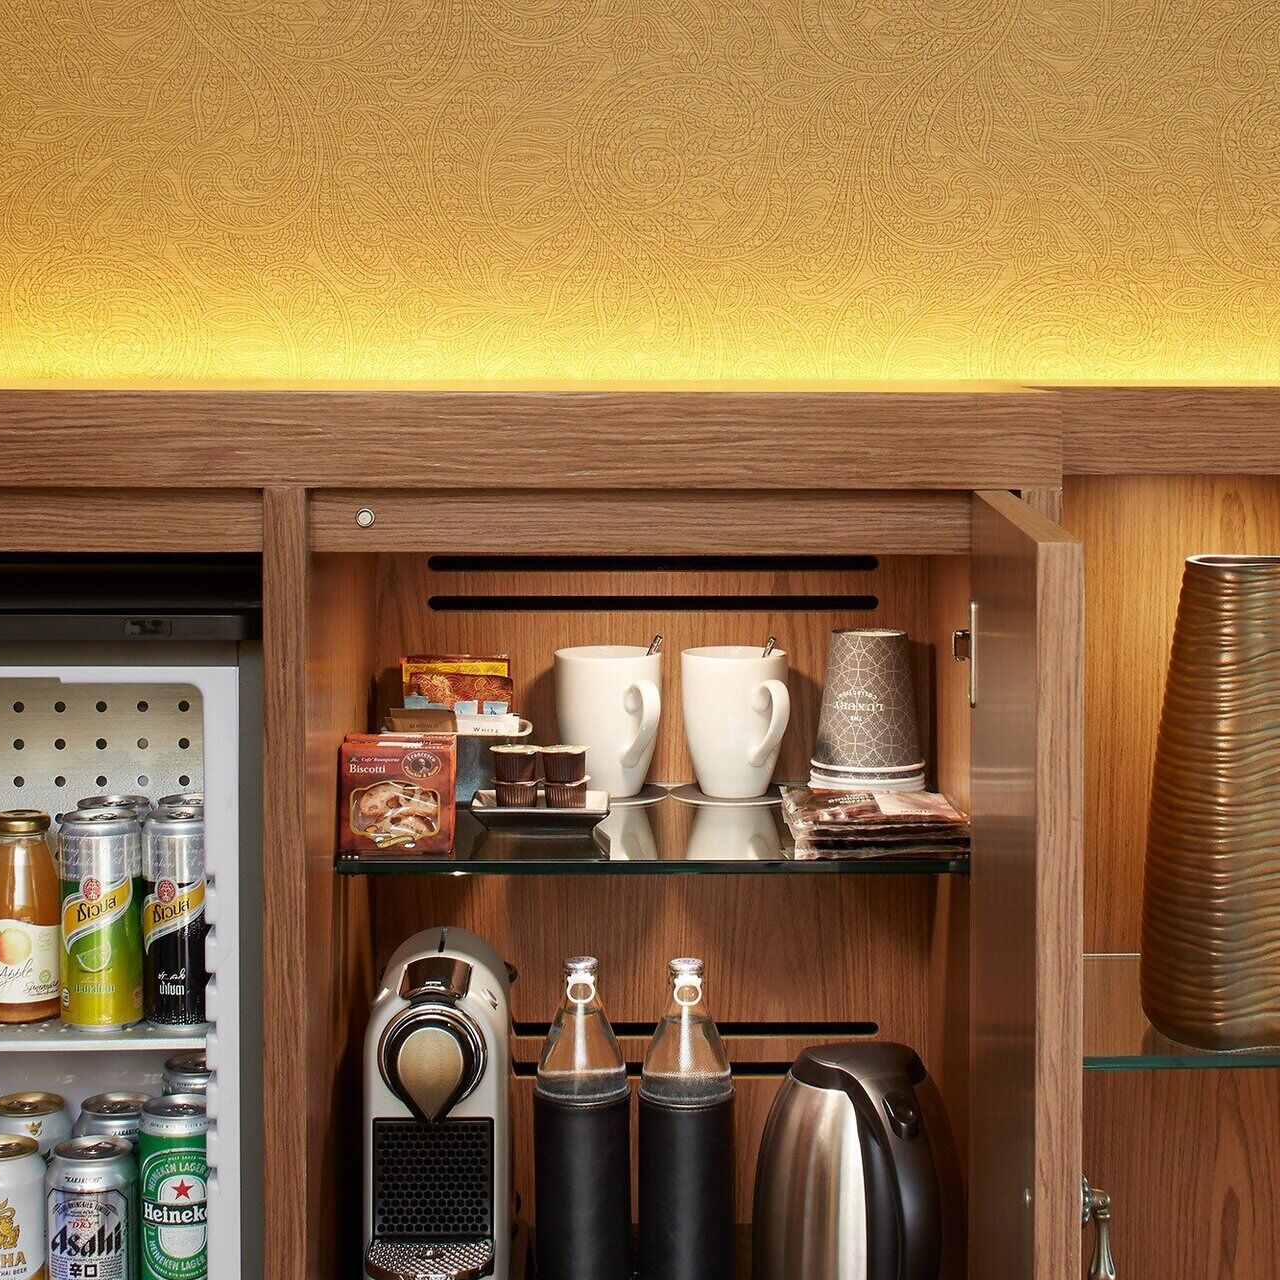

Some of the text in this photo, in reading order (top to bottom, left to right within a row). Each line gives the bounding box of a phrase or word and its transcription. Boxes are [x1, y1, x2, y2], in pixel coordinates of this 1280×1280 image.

[832, 700, 885, 711] LUXURY
[349, 764, 386, 774] Biscotti
[179, 1162, 204, 1175] LAGER
[51, 1221, 123, 1257] Asahi
[13, 1267, 28, 1275] BEER
[69, 1263, 98, 1279] 辛口
